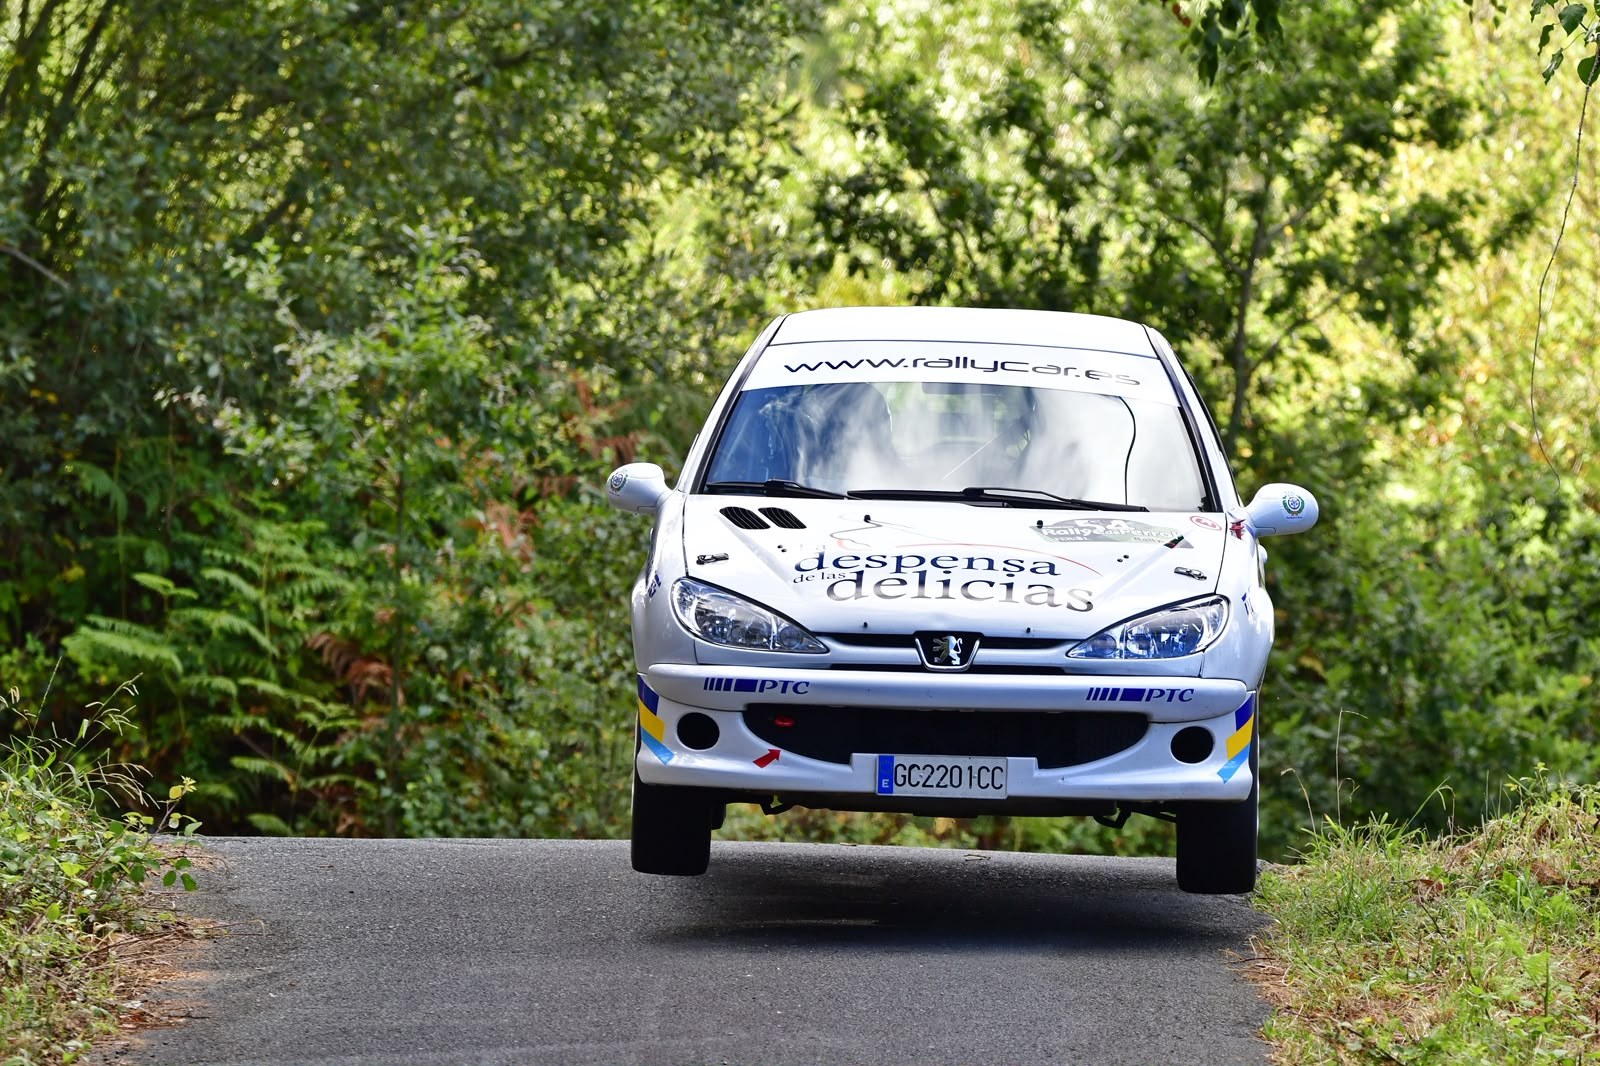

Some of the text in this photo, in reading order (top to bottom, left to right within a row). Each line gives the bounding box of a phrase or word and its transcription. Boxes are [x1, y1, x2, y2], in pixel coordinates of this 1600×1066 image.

[784, 356, 1140, 386] www.rallycar.es
[794, 551, 1062, 575] despensa
[793, 572, 846, 584] de las
[826, 570, 1094, 612] delicias
[758, 680, 810, 695] PTC
[1144, 688, 1195, 703] PTC
[881, 779, 890, 789] E
[894, 763, 1004, 790] GC2201CC
